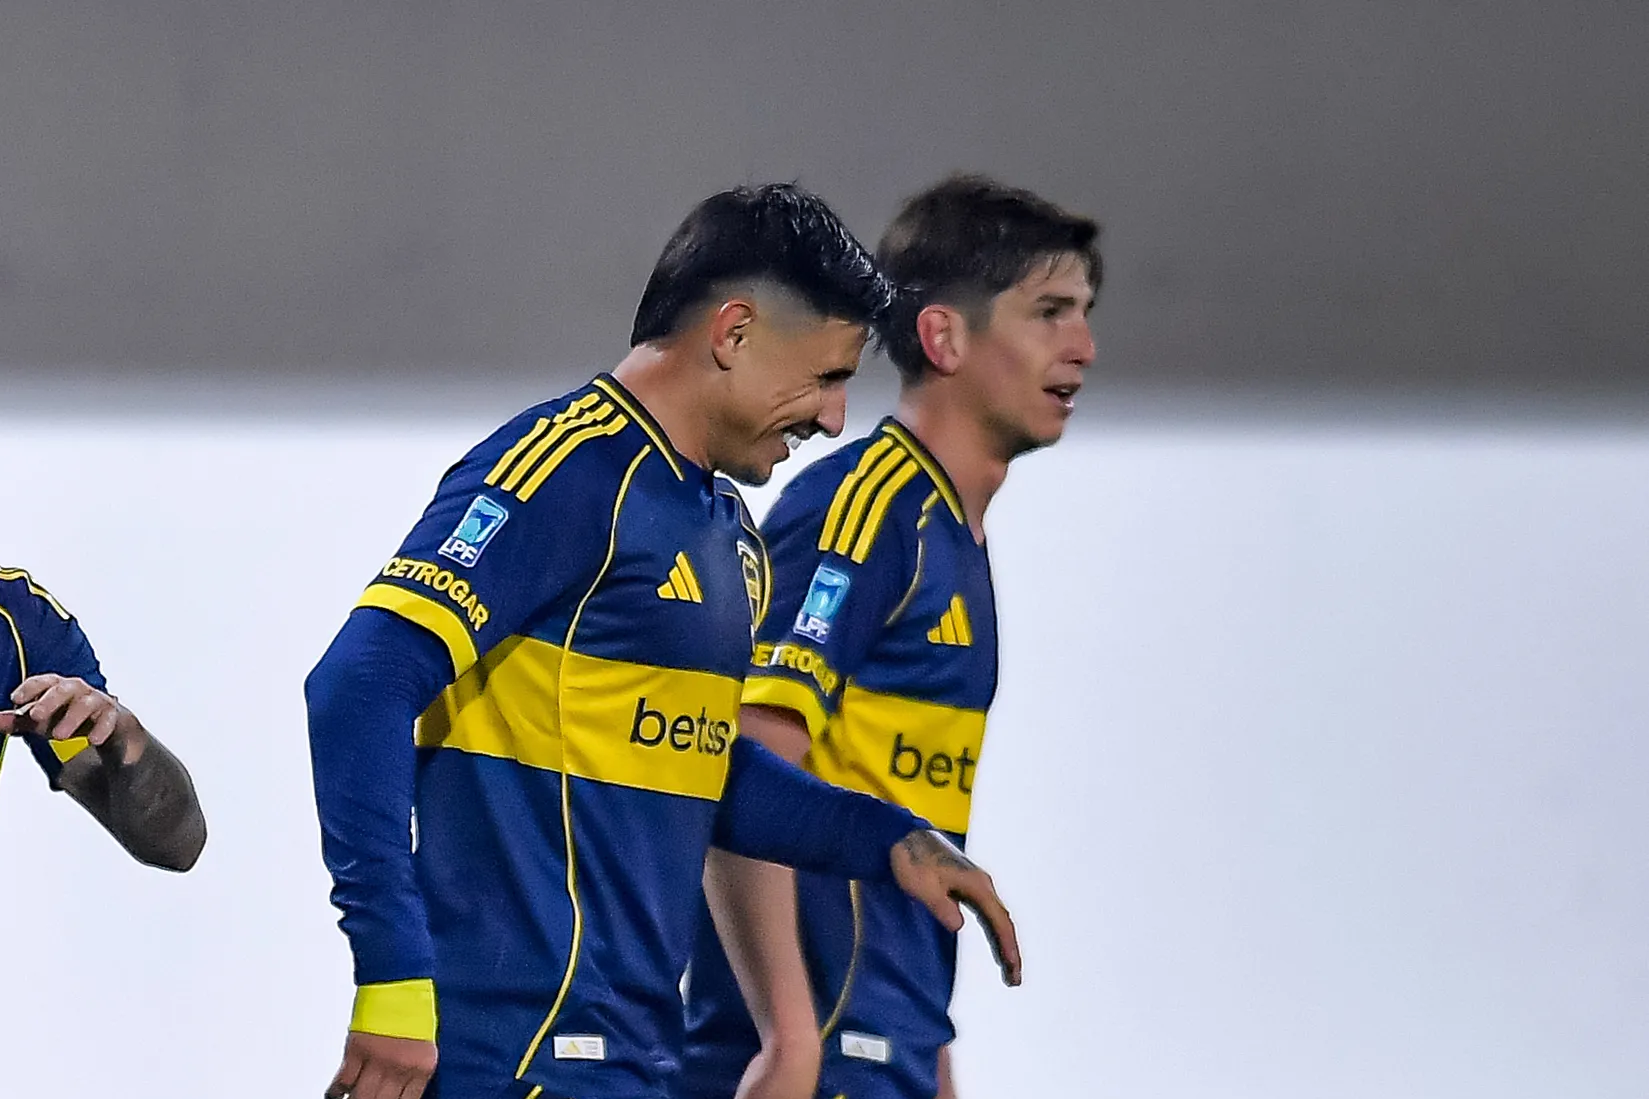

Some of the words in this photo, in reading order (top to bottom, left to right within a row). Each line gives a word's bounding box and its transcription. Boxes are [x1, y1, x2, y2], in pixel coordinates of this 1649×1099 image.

[444, 538, 478, 561] LPF
[382, 557, 490, 632] CETROGAR
[890, 732, 975, 795] bet
